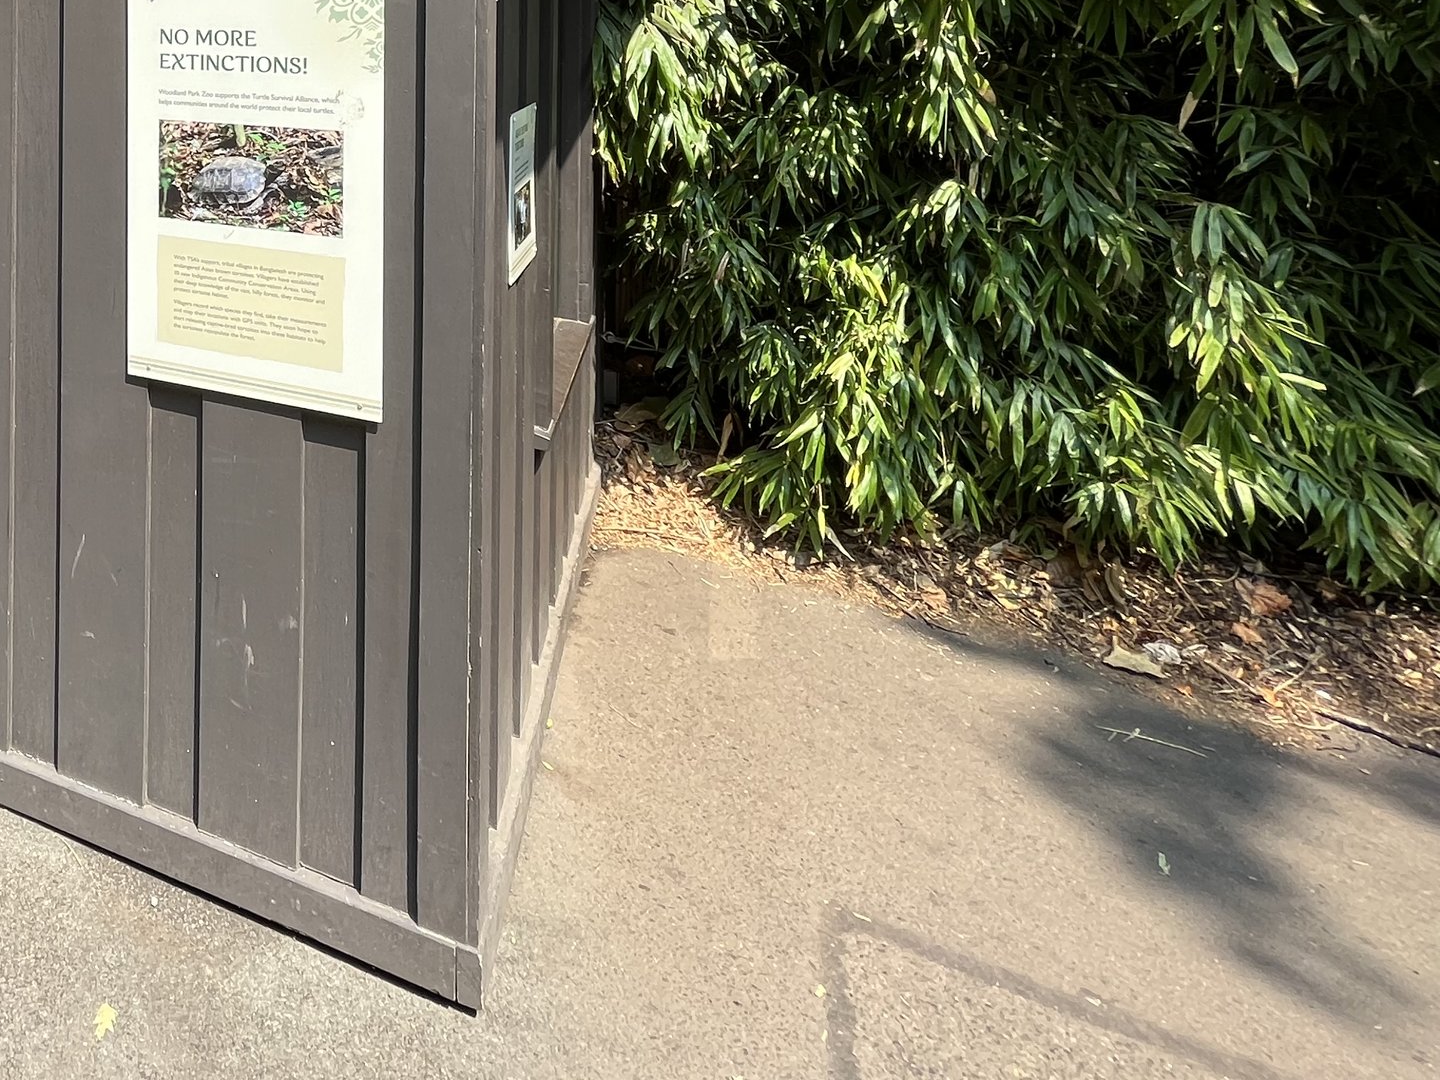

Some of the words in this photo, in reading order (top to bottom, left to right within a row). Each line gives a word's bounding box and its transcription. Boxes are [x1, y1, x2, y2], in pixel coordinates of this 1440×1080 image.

[160, 28, 189, 45] NO
[195, 29, 257, 47] MORE
[160, 53, 308, 74] EXTINCTIONS!
[158, 98, 172, 106] helps
[173, 100, 207, 108] communities
[201, 90, 213, 98] Zoo
[215, 92, 239, 100] supports
[271, 94, 293, 102] Survival
